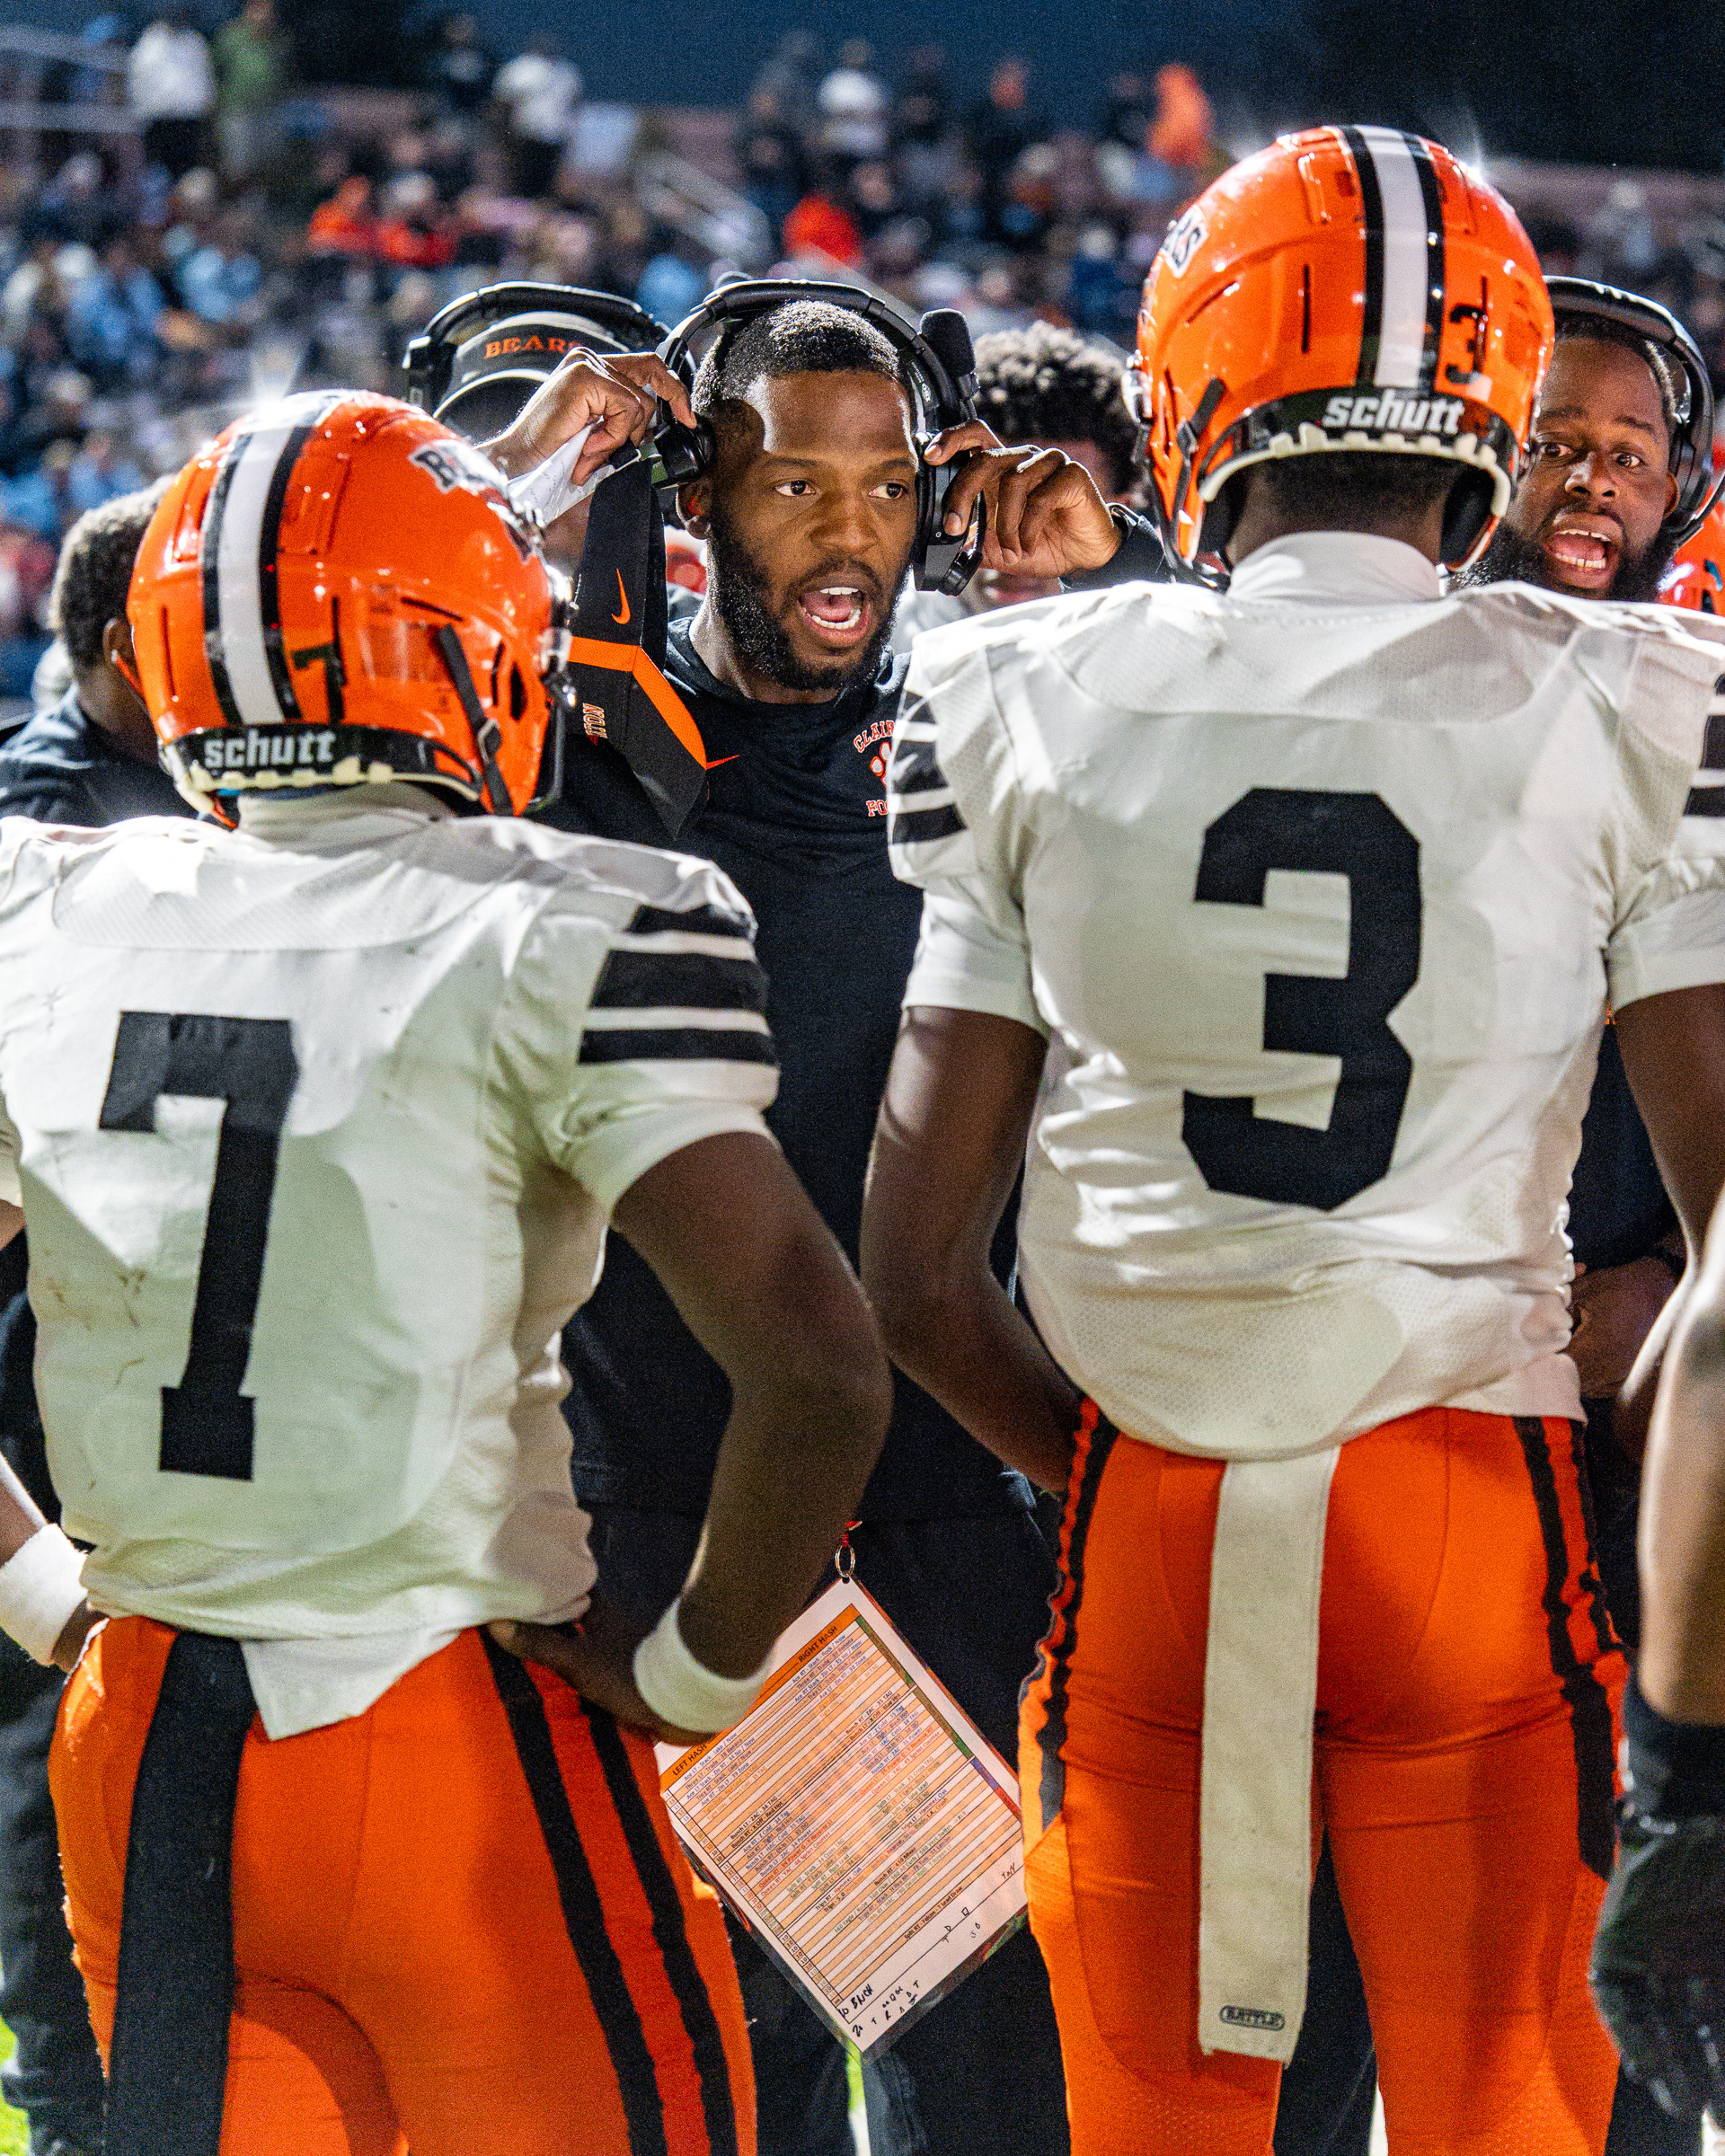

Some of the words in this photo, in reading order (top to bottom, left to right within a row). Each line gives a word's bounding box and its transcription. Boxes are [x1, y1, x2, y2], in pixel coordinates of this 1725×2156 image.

[1445, 302, 1486, 384] 3
[1322, 389, 1465, 434] schutt
[289, 641, 346, 724] 7
[204, 728, 336, 769] schutt
[1181, 786, 1424, 1213] 3
[98, 1010, 302, 1482] 7
[792, 1674, 801, 1683] Ace
[808, 1657, 819, 1669] Stack
[821, 1646, 832, 1657] Rock
[834, 1633, 845, 1645] Now
[798, 1641, 819, 1662] RIGHT
[818, 1625, 837, 1644] HASH
[845, 1720, 859, 1734] Bunch
[865, 1706, 875, 1716] ZAC
[882, 1690, 892, 1700] TAG
[672, 1759, 688, 1775] LEFT
[687, 1742, 707, 1762] HASH
[683, 1772, 693, 1780] Ace
[699, 1754, 712, 1767] Stack
[712, 1744, 723, 1754] Lake
[726, 1731, 737, 1743] Now
[730, 1825, 744, 1840] Bunch
[750, 1812, 759, 1821] ZAC
[767, 1795, 777, 1806] TAG
[731, 1834, 745, 1849] Bunch
[756, 1817, 765, 1826] Off
[765, 1808, 774, 1817] Red
[774, 1800, 783, 1810] Hot
